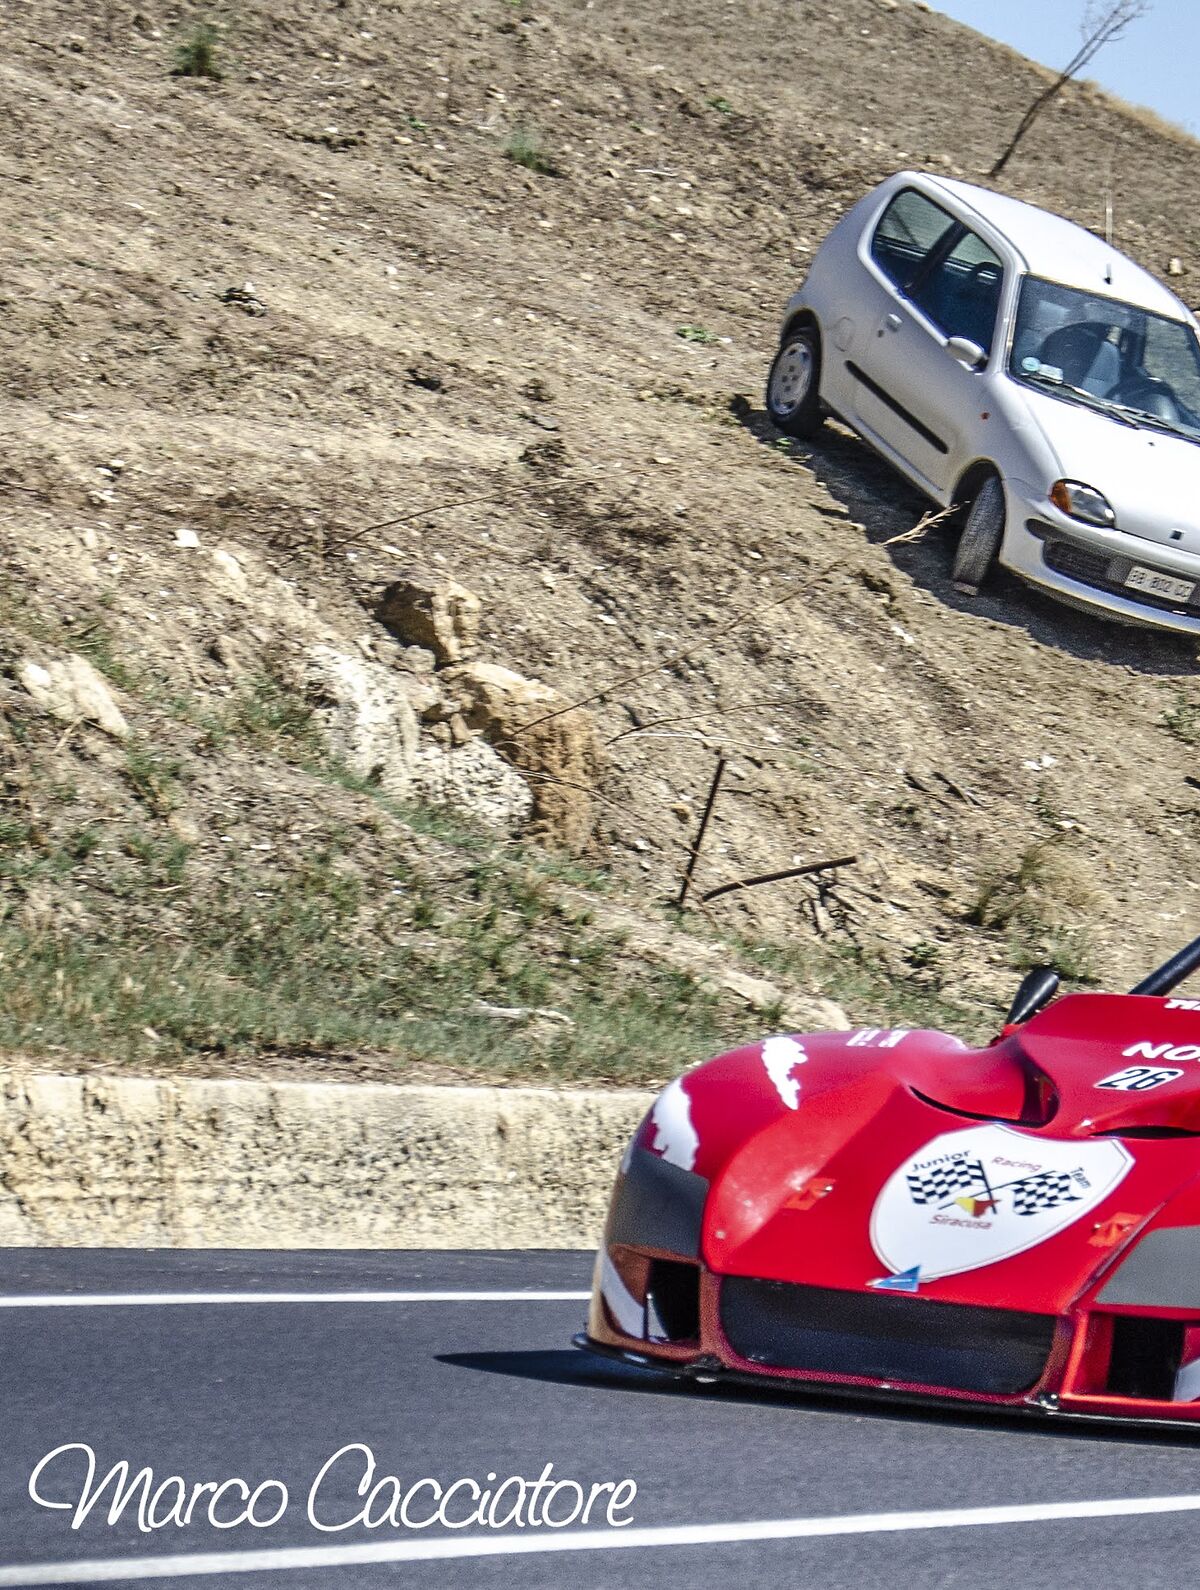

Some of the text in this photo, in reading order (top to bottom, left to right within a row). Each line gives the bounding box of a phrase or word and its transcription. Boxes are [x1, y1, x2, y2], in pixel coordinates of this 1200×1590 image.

[1098, 1068, 1178, 1091] 26
[911, 1149, 1094, 1190] Junior Racing Team
[928, 1212, 994, 1231] Siracusa
